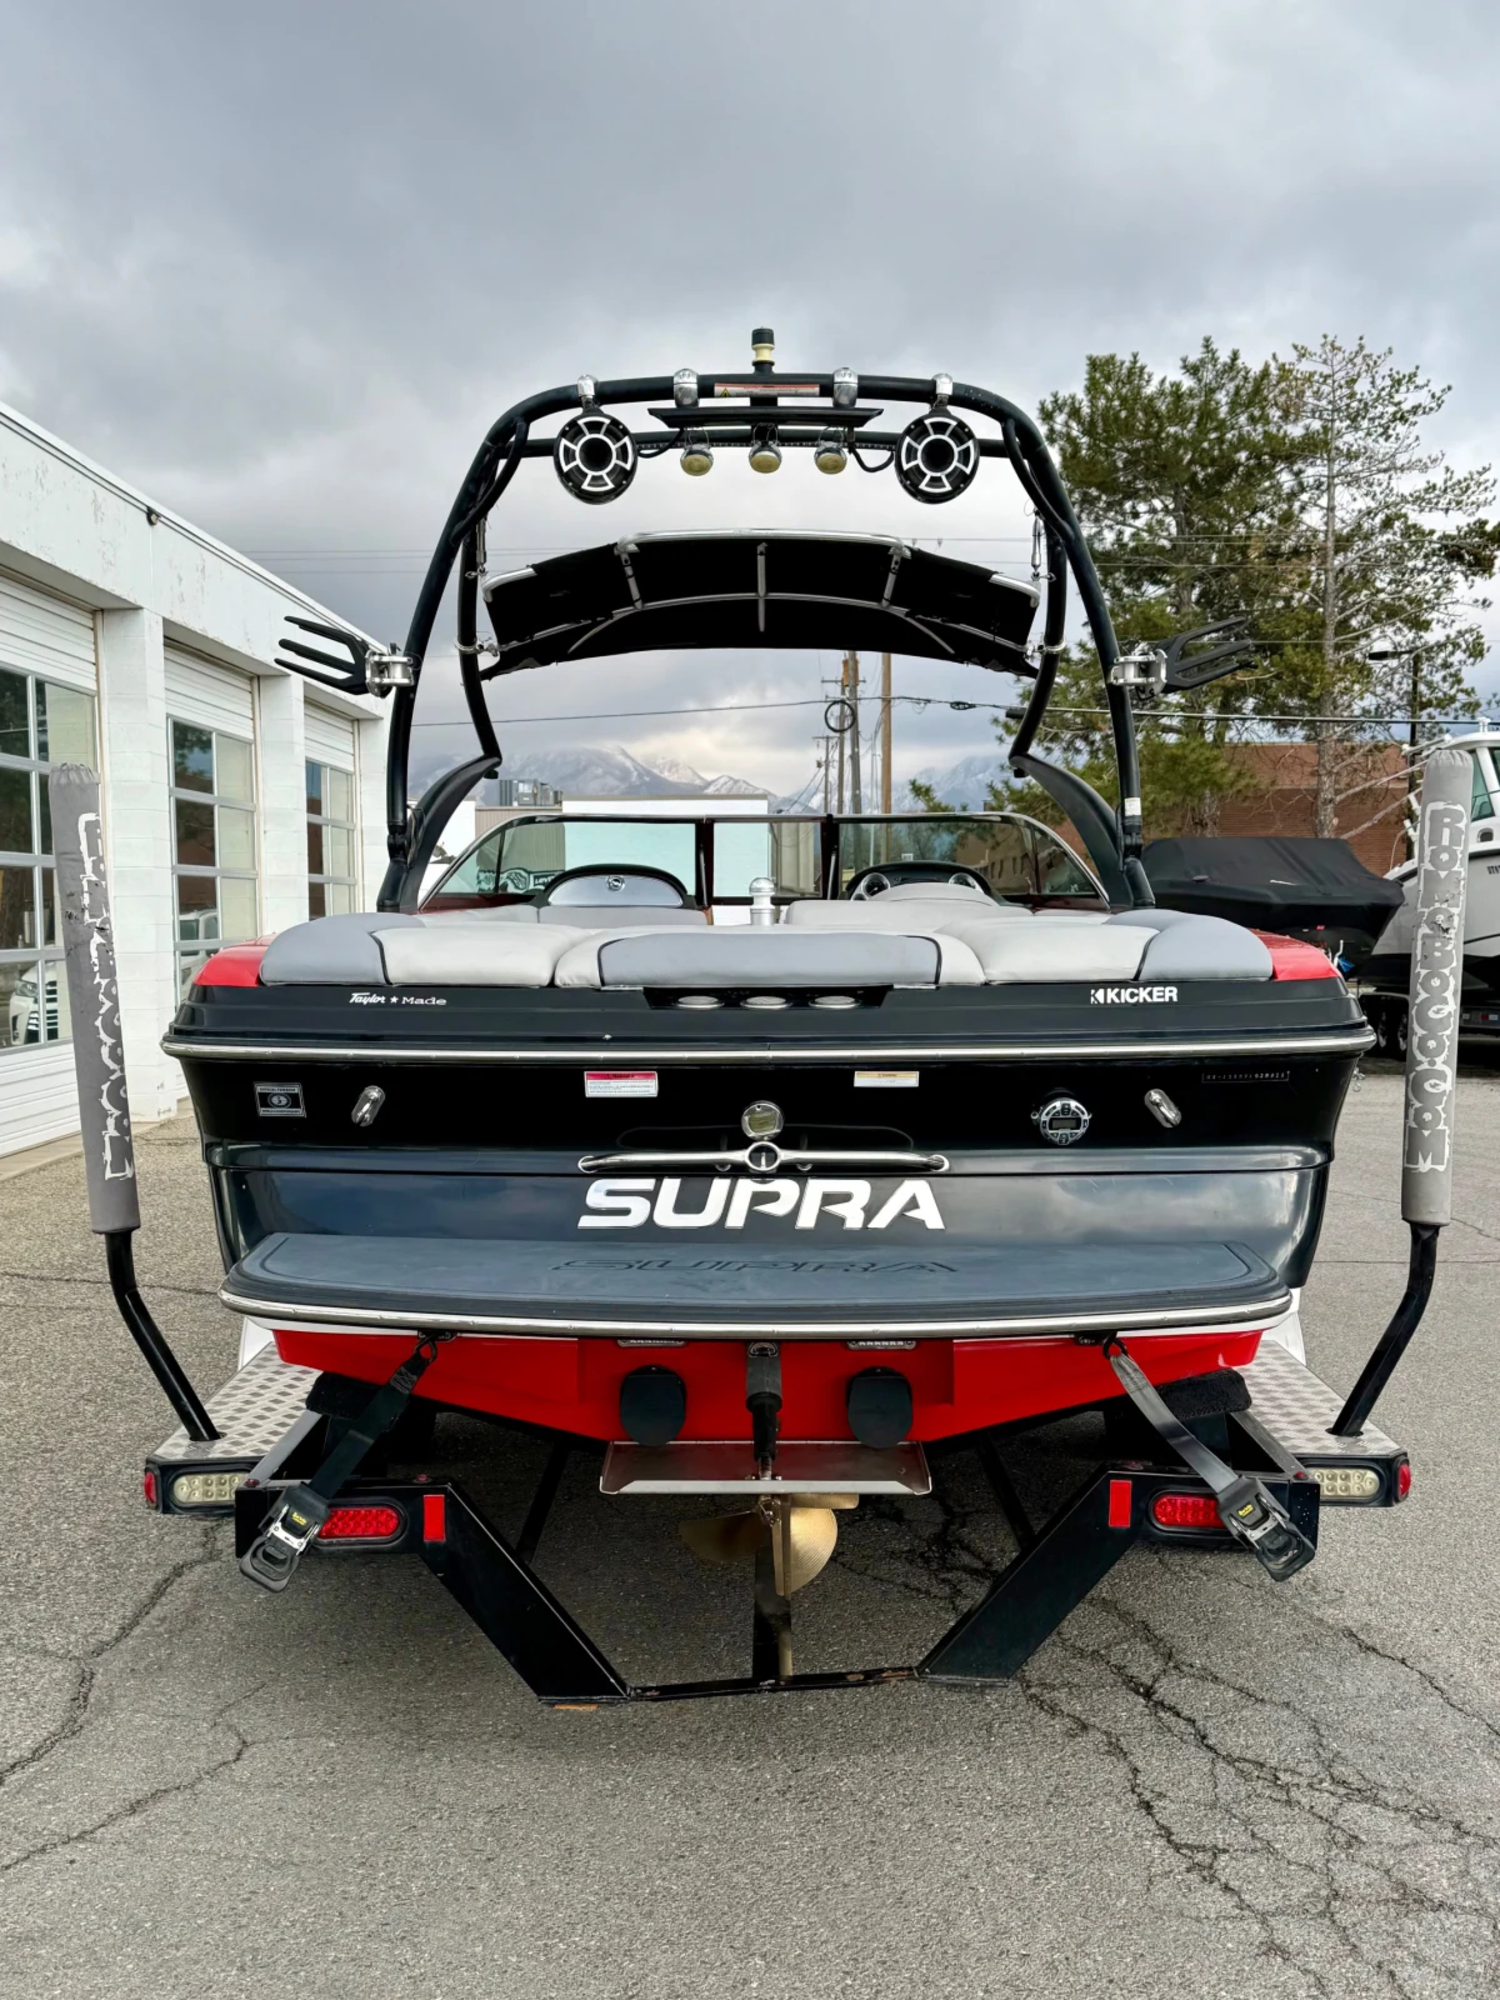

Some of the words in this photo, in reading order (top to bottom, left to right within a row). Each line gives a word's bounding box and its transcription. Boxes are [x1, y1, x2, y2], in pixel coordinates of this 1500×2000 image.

[349, 991, 387, 1006] Taylor
[401, 996, 447, 1006] Made
[1106, 986, 1178, 1004] KICKER
[577, 1178, 946, 1231] SUPRA
[551, 1259, 958, 1273] SUPRA
